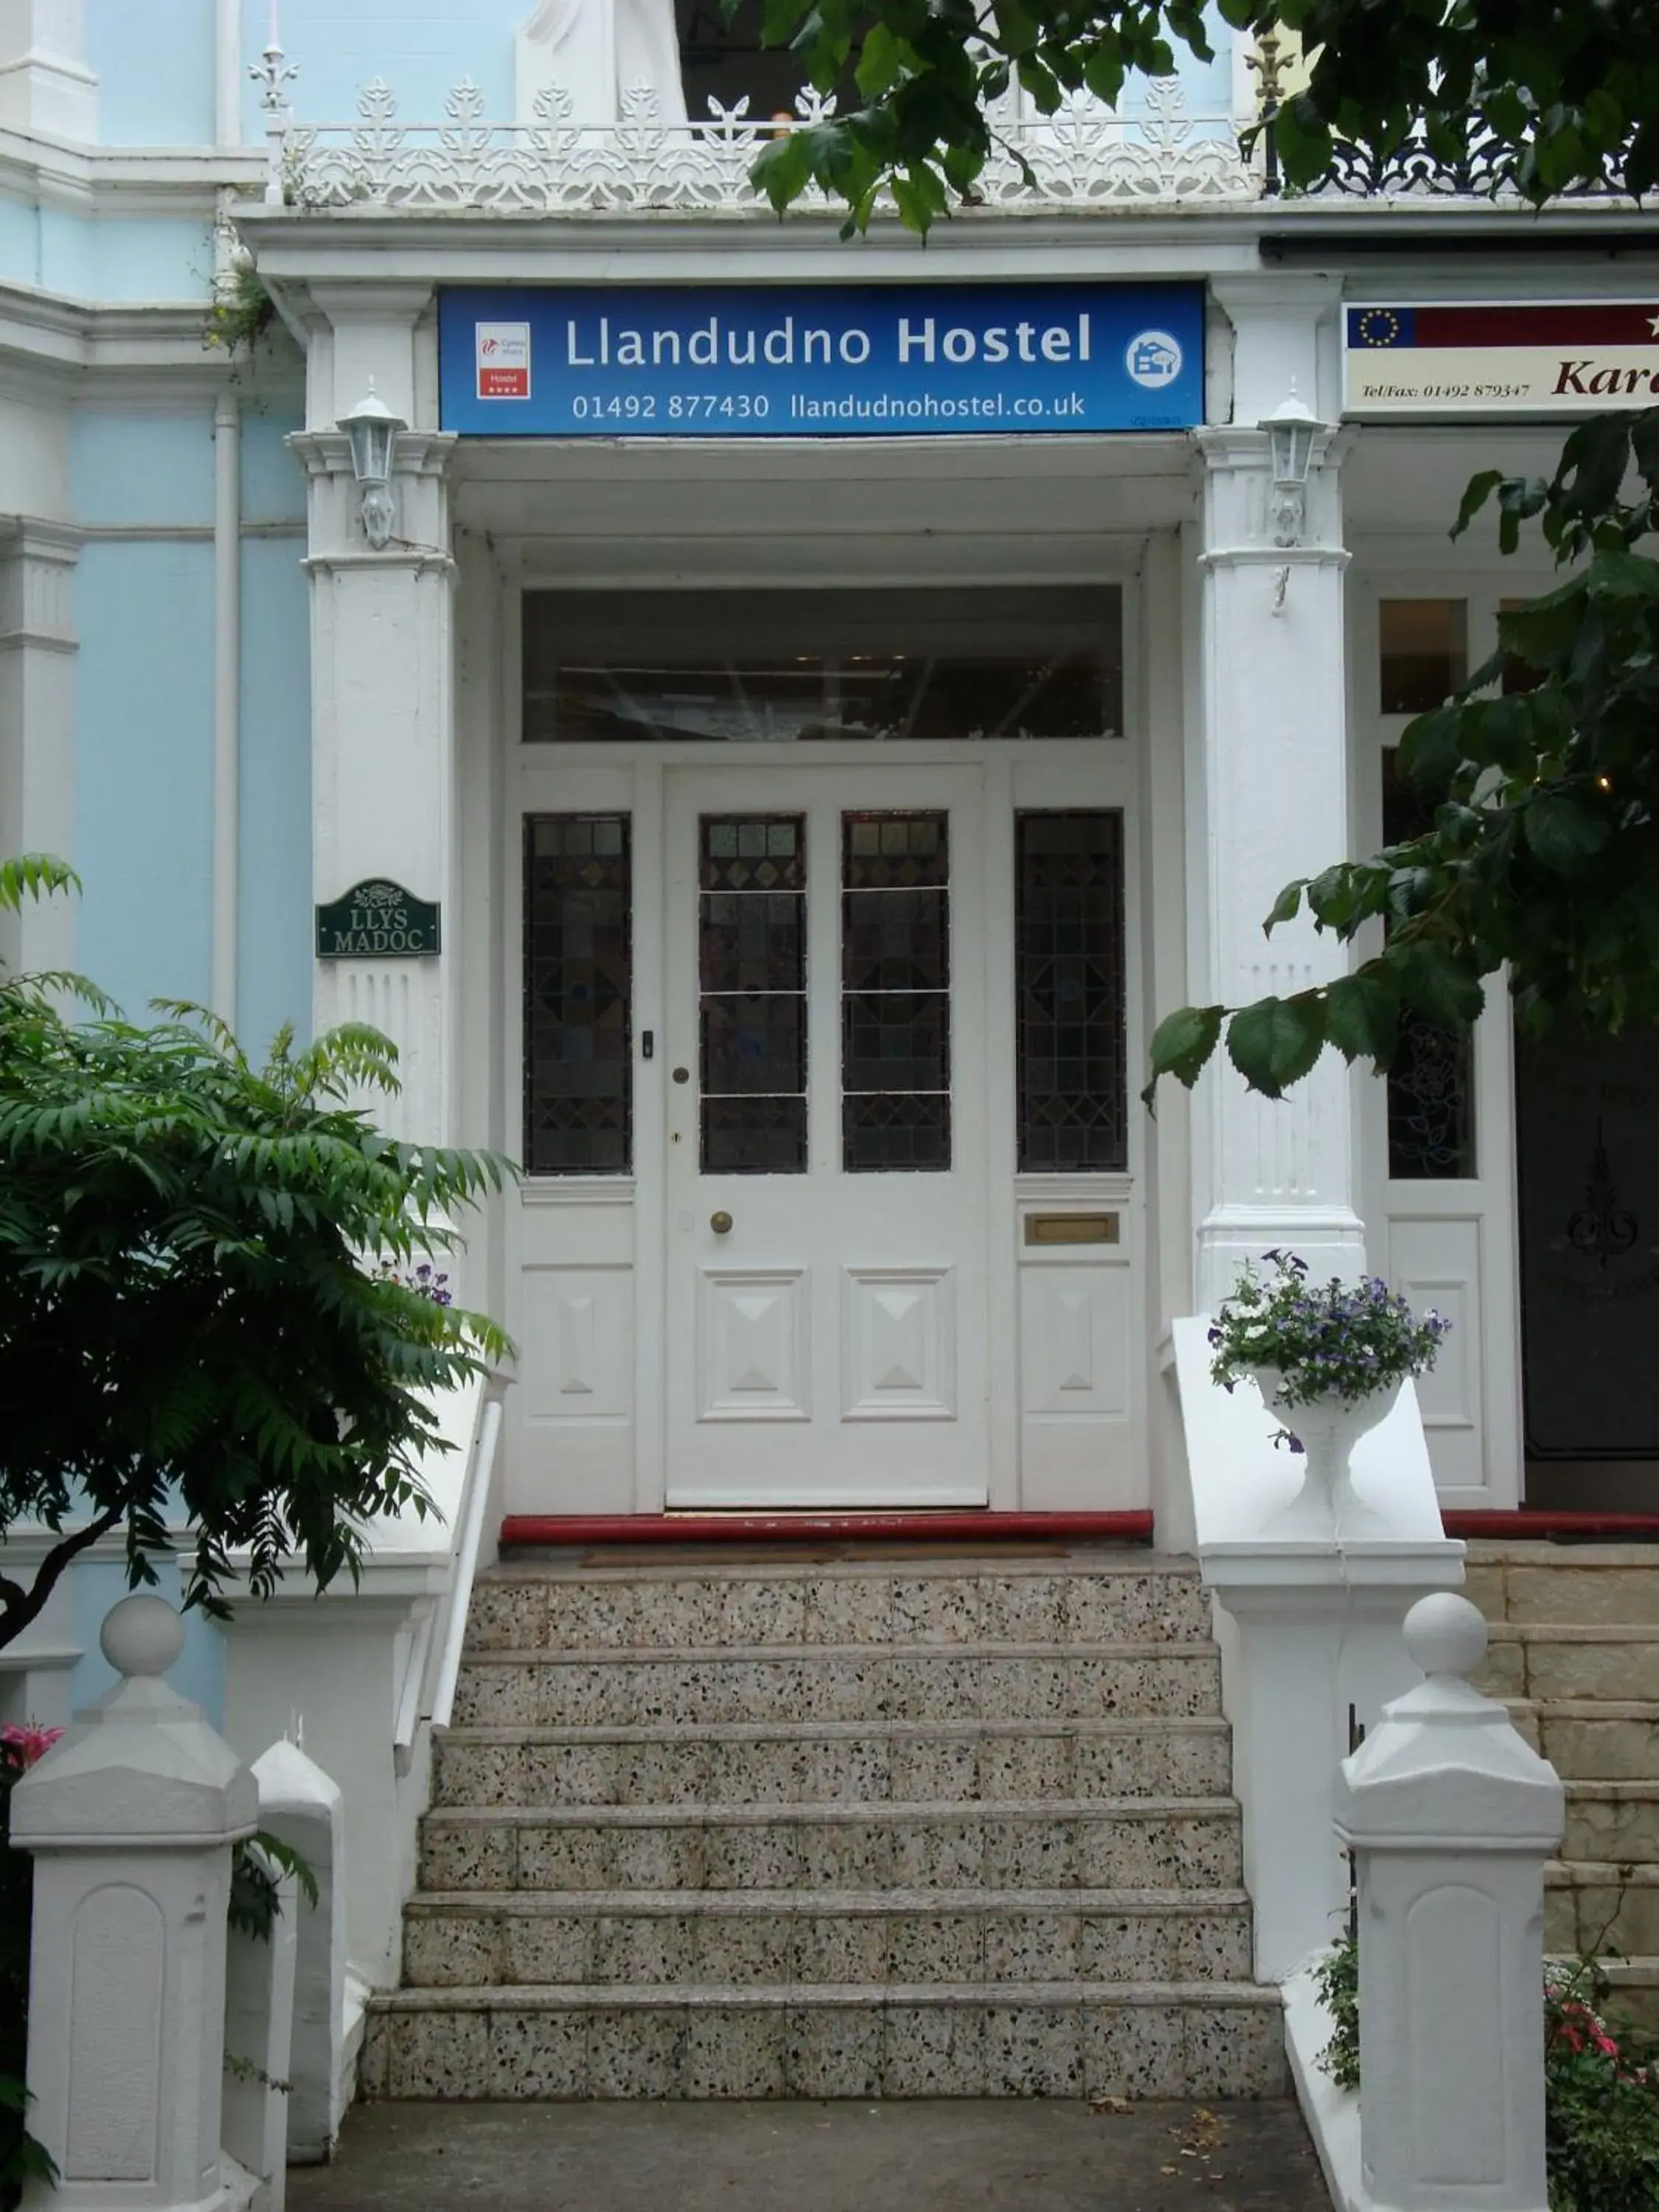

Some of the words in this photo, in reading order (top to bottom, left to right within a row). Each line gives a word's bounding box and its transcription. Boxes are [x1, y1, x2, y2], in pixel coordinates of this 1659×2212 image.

[567, 316, 870, 366] Llandudno
[898, 313, 1090, 364] Hostel
[1363, 385, 1419, 398] Tel/Fax:
[1424, 385, 1470, 397] 01492
[1473, 384, 1530, 398] 879347
[572, 395, 655, 419] 01492
[669, 394, 769, 418] 877430
[791, 392, 1085, 418] llandudnohostel.co.uk
[349, 908, 408, 931] LLYS
[333, 930, 424, 952] MADOC
